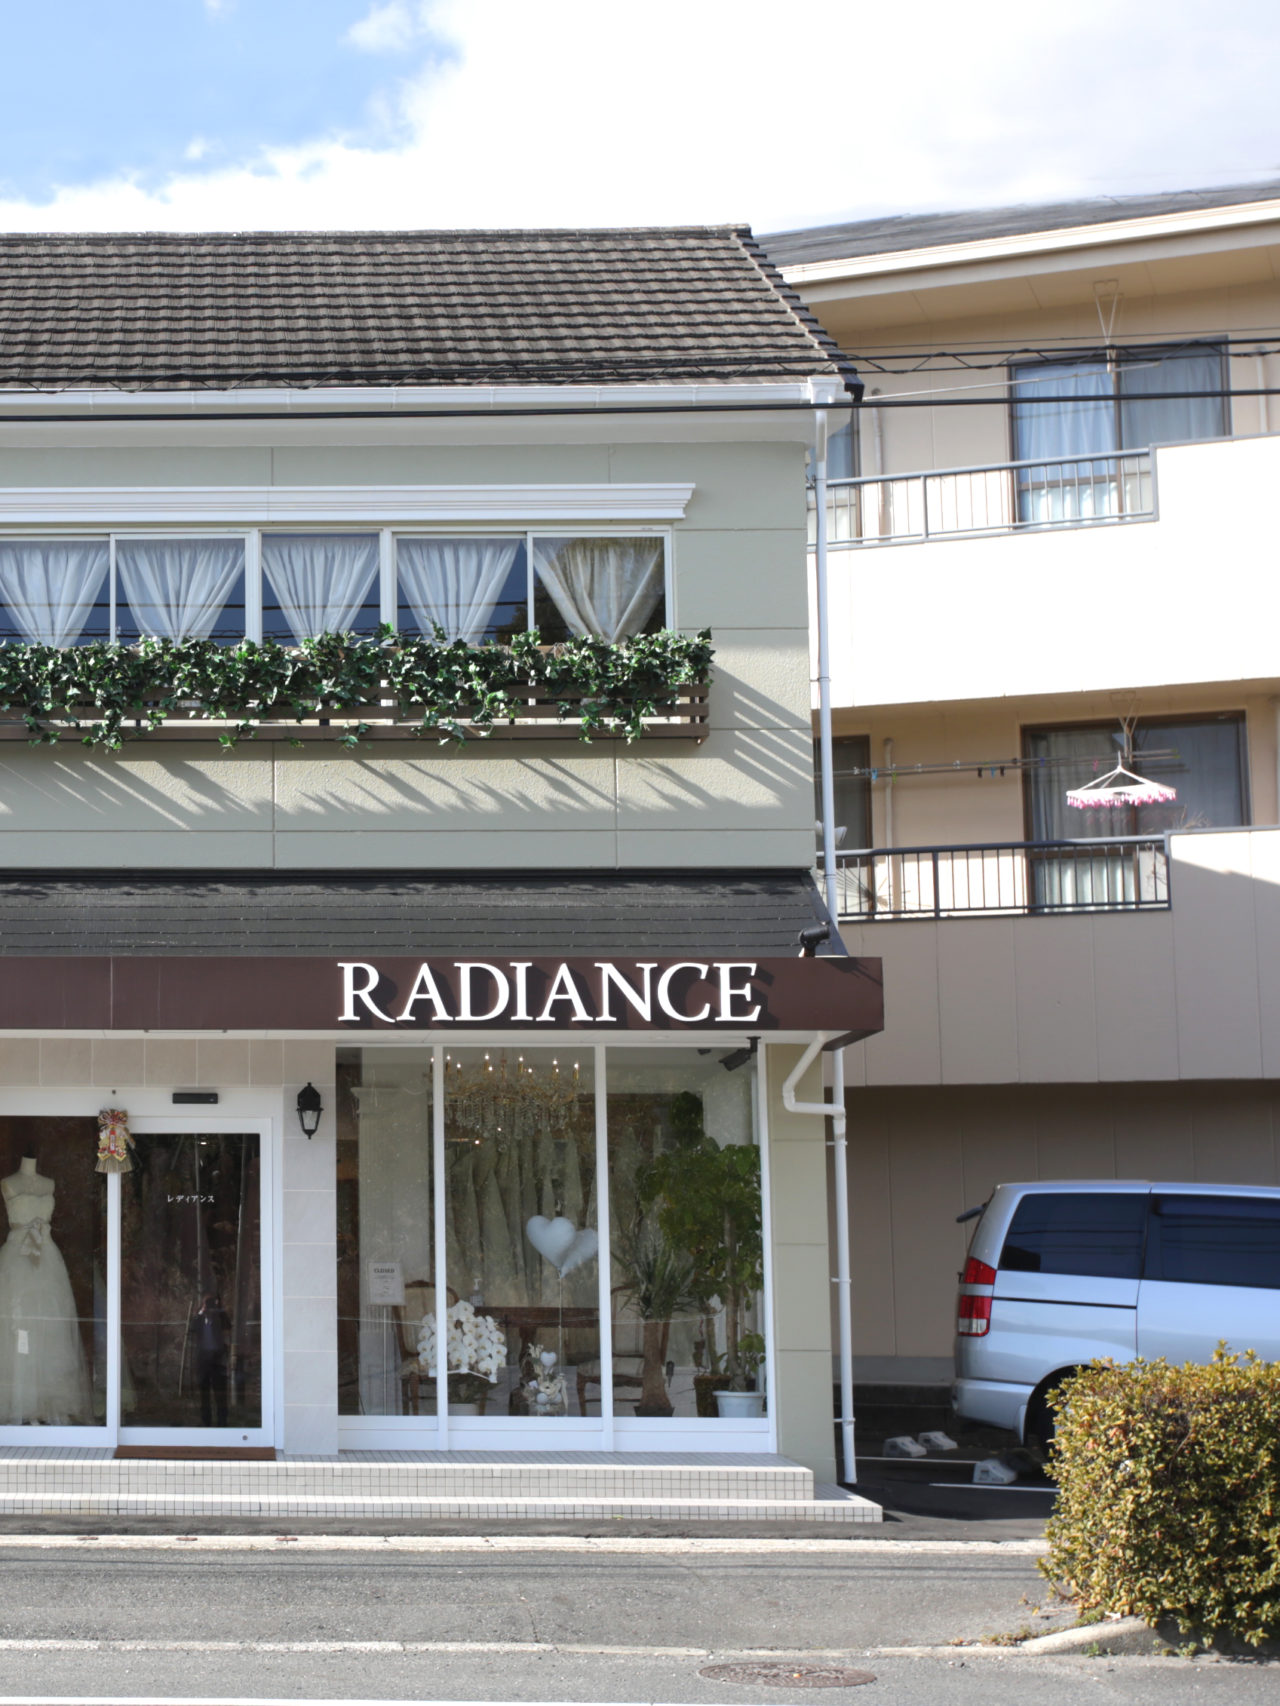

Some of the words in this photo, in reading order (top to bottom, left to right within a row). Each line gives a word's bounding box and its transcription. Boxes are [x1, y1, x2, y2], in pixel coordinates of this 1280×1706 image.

[337, 962, 762, 1023] RADIANCE
[167, 1194, 215, 1203] レディアンス
